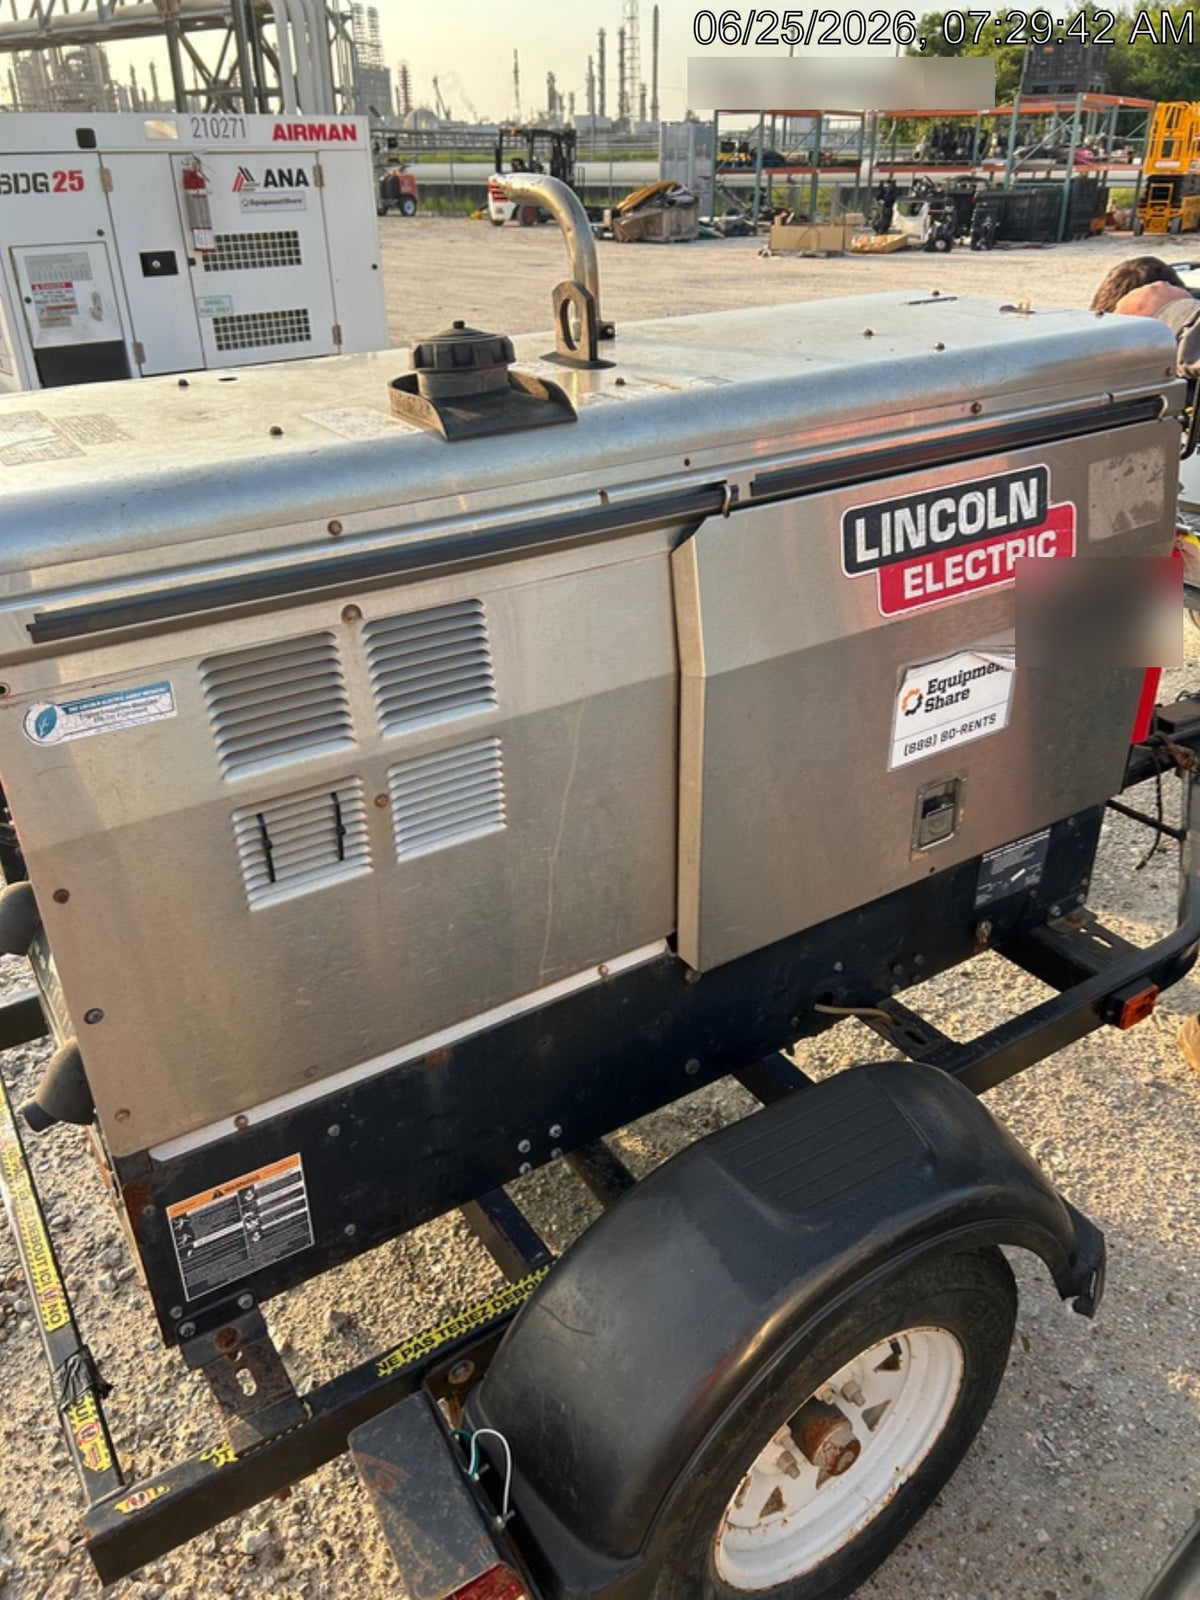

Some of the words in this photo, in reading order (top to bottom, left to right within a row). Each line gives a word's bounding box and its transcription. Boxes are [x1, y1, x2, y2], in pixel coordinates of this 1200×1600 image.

[191, 117, 246, 139] 210271
[272, 123, 358, 142] AIRMAN
[263, 168, 310, 188] ANA
[854, 477, 1038, 563] LINCOLN
[903, 530, 1057, 600] ELECTRIC
[924, 688, 972, 714] Share
[27, 1221, 48, 1267] DEBOUT
[401, 1336, 435, 1359] PAS
[437, 1306, 489, 1339] TENEZ
[492, 1278, 540, 1310] DEBO
